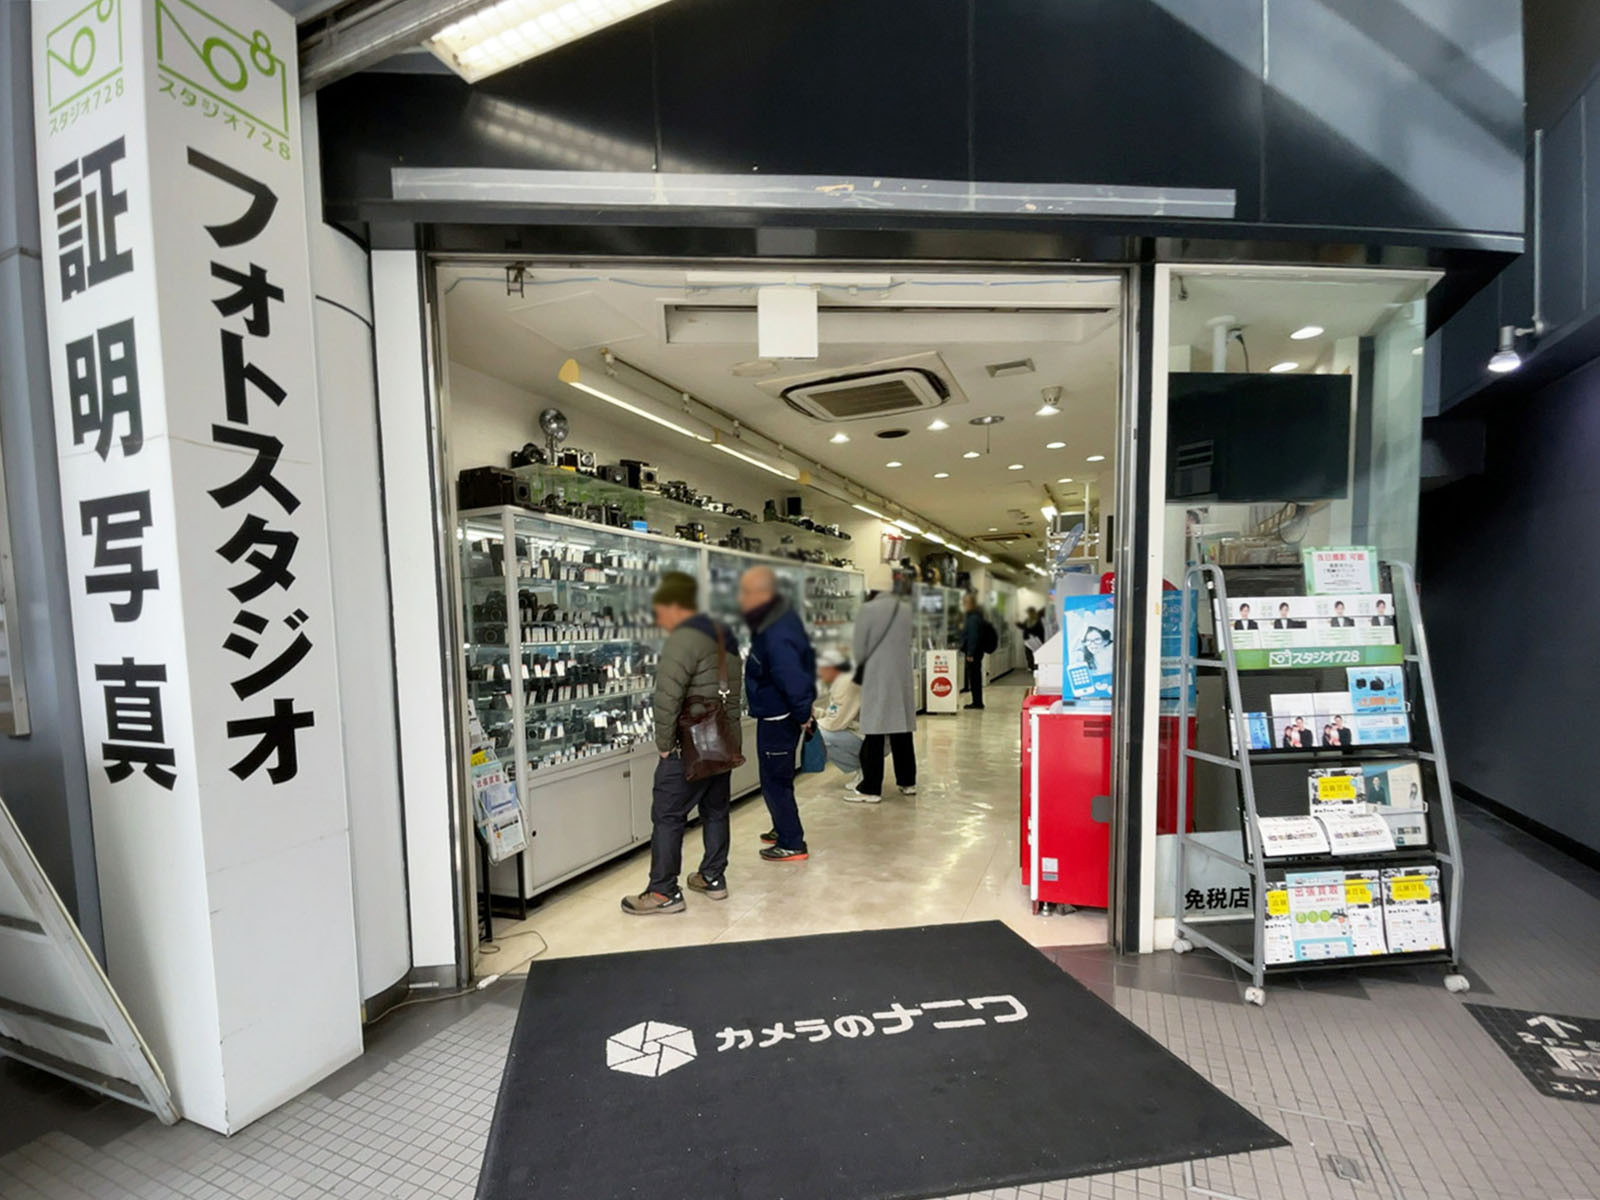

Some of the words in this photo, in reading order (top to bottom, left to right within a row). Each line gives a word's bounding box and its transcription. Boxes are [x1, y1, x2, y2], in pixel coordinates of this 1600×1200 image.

[50, 77, 124, 137] スタジオ728
[156, 74, 292, 161] スタジオ728
[53, 134, 178, 791] 証明写真
[186, 145, 315, 785] フォトスタジオ
[1292, 650, 1361, 665] スタジオ728
[1184, 886, 1250, 910] 免税店
[715, 994, 1029, 1052] カメラのナニワ
